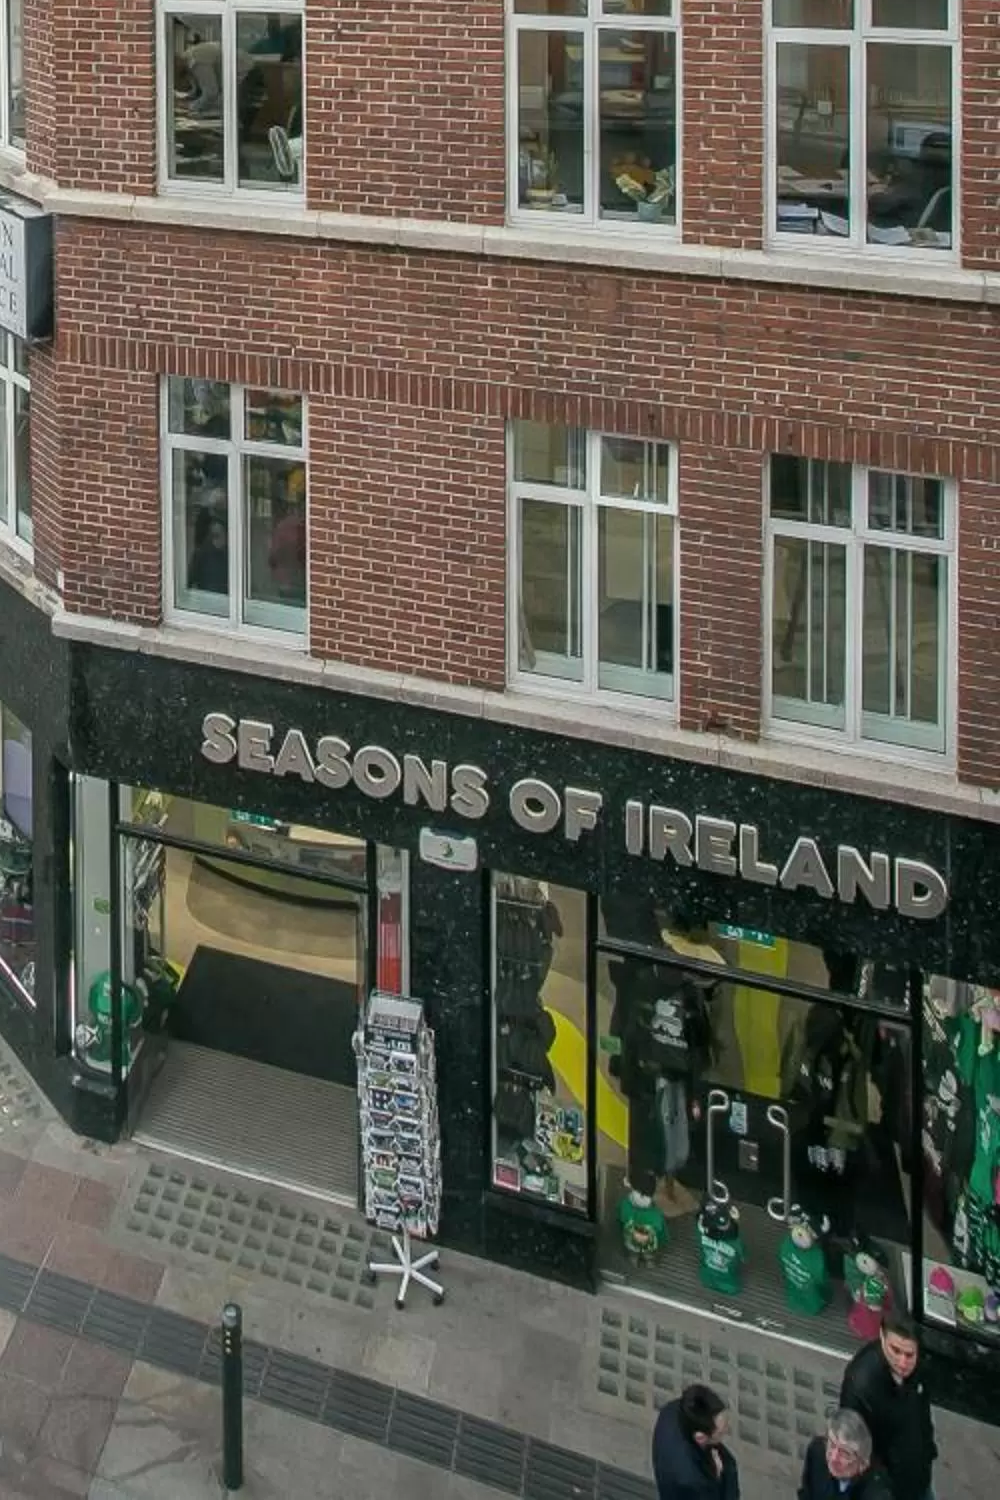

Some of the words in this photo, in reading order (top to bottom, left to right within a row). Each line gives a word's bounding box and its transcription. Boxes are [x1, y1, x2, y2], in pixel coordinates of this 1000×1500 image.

[201, 712, 490, 818] SEASONS
[509, 777, 602, 840] OF
[625, 799, 948, 918] IRELAND
